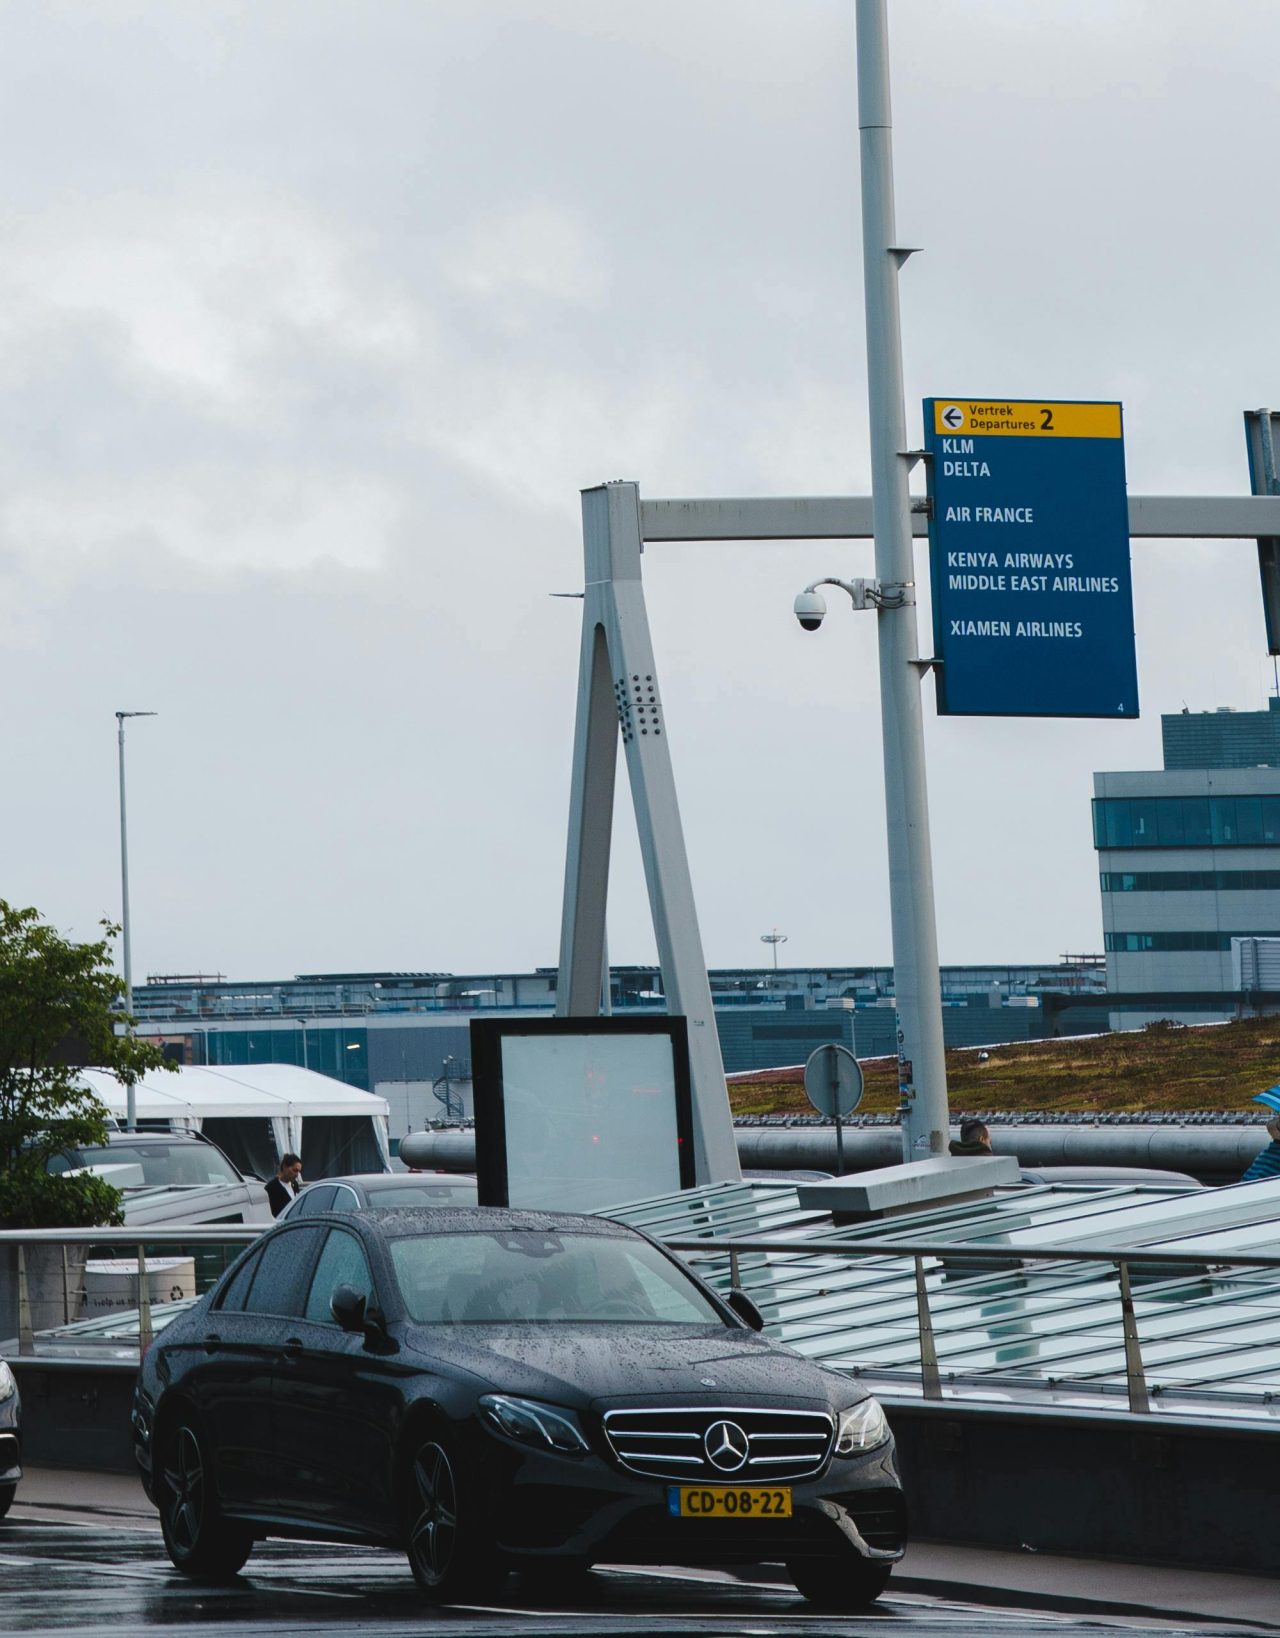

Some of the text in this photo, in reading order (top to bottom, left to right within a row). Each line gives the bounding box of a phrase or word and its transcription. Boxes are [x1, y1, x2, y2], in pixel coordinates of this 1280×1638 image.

[969, 405, 1013, 417] Vertrek
[1040, 408, 1054, 431] 2
[970, 418, 1036, 431] Departures
[942, 438, 974, 454] KLM
[943, 461, 991, 477] DELTA
[945, 506, 1034, 523] AIR FRANCE
[947, 552, 1074, 569] KENYA AIRWAYS
[948, 574, 1119, 593] MIDDLE EAST AIRLINES
[950, 620, 1083, 638] XIAMEN AIRLINES
[1117, 702, 1124, 713] 4
[686, 1491, 786, 1514] CD-08-22
